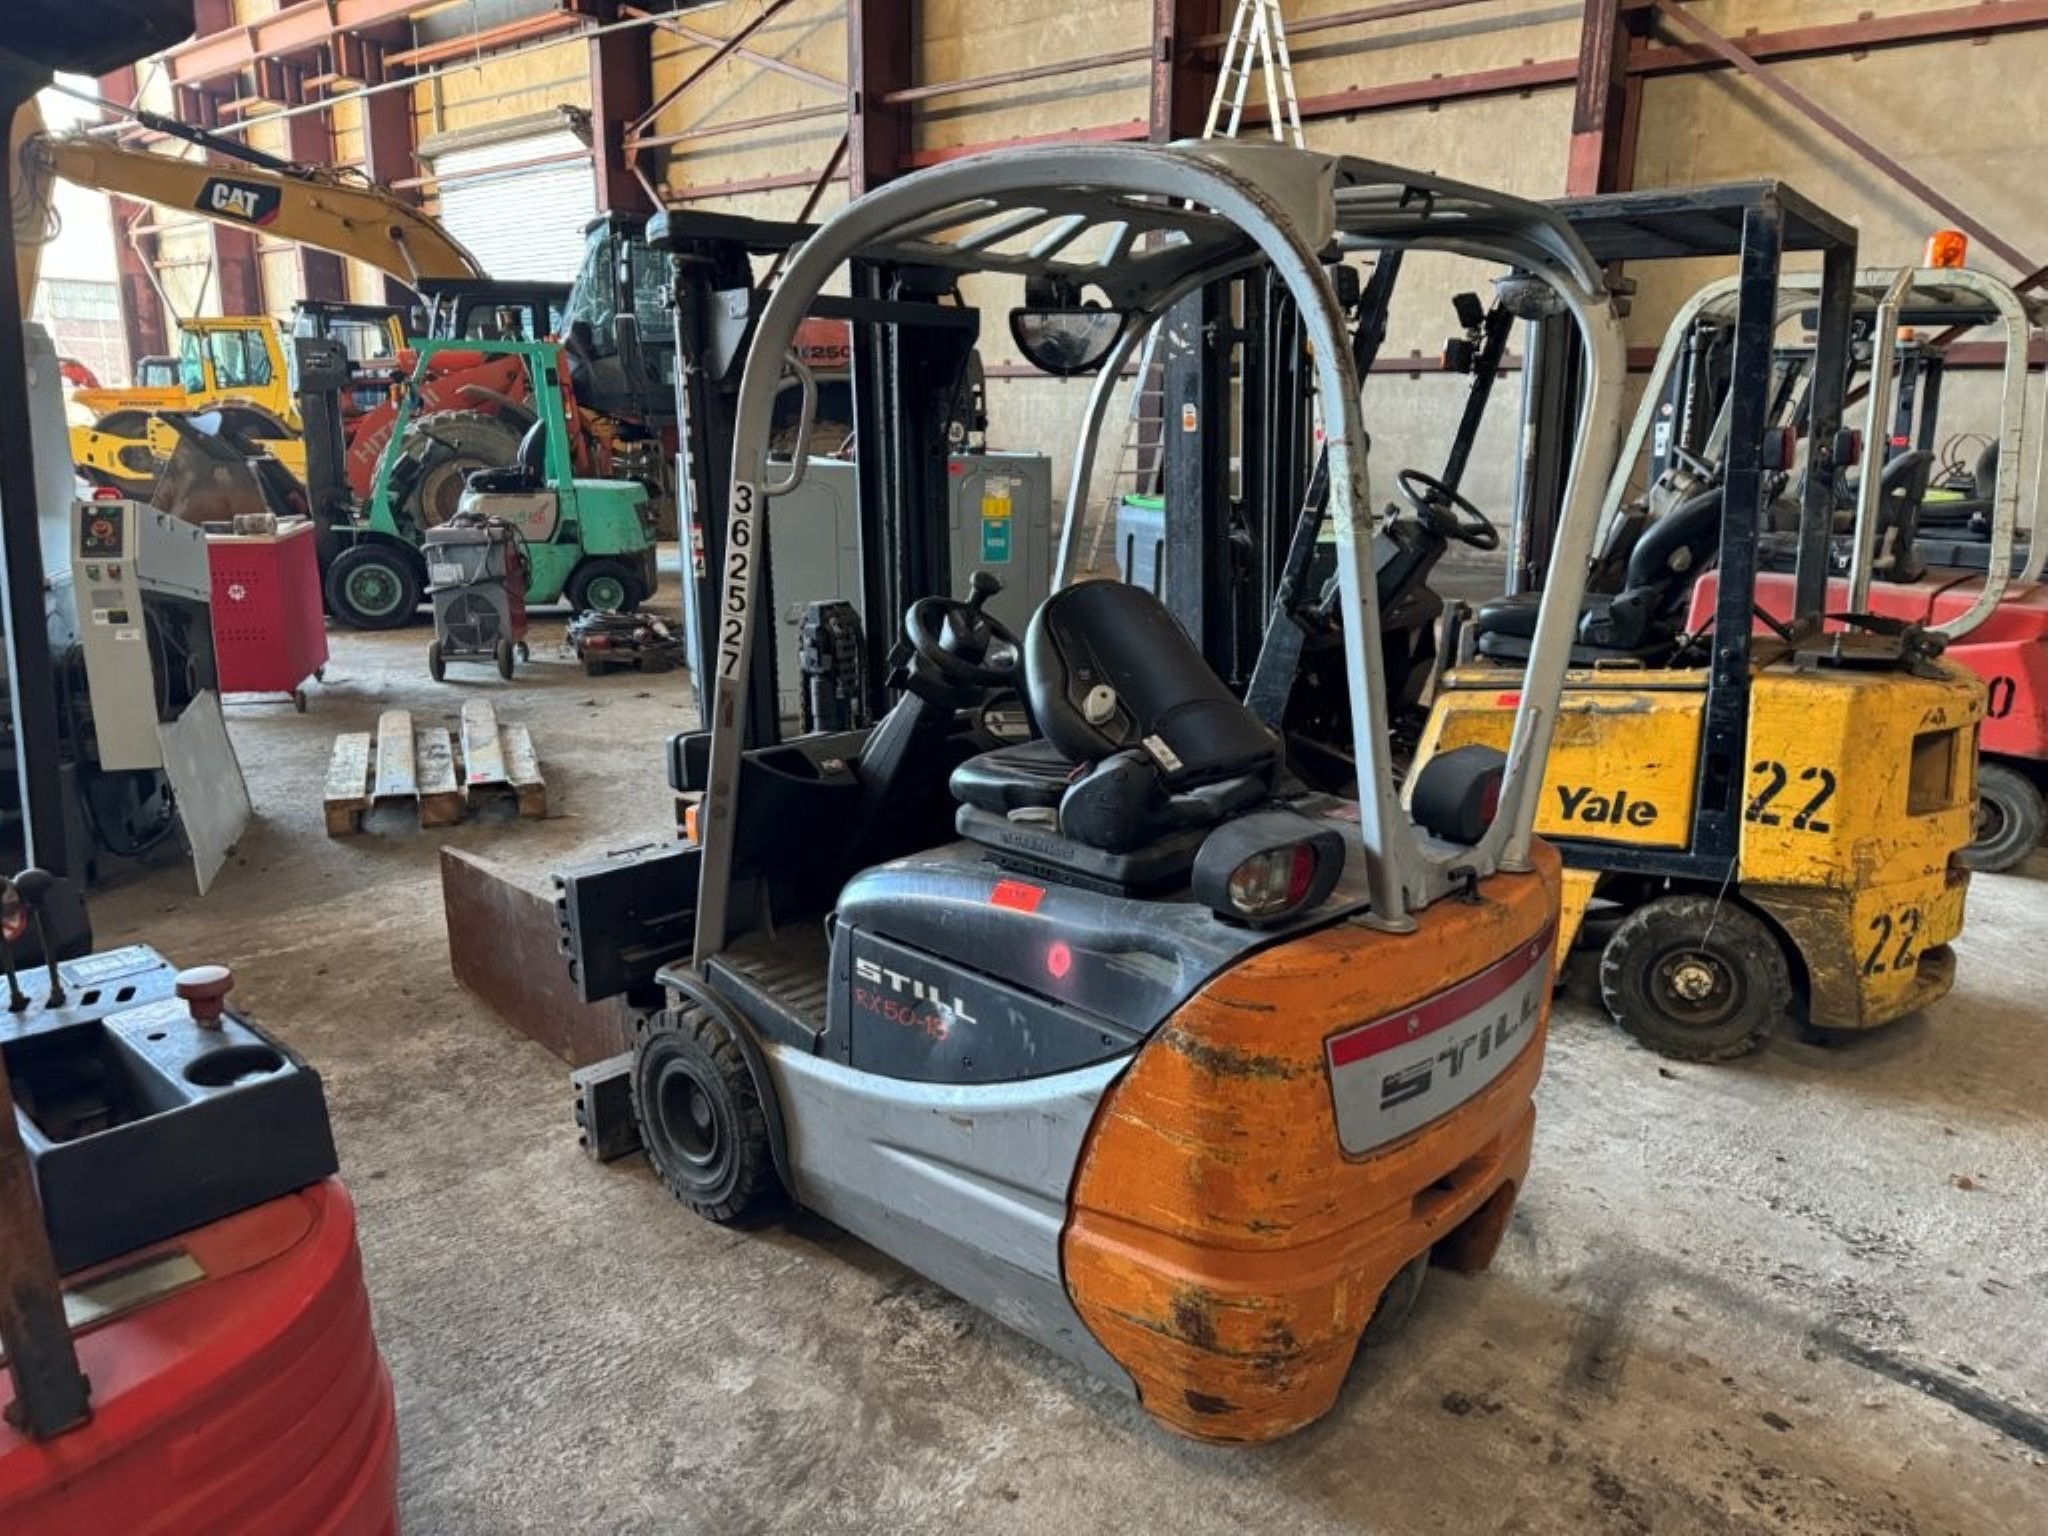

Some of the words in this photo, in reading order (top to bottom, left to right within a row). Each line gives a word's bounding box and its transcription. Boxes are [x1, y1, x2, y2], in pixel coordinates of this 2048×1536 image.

[211, 183, 259, 219] CAT
[721, 484, 753, 676] 362527
[1557, 784, 1659, 828] Yale
[1745, 760, 1837, 834] 22
[1863, 907, 1920, 977] 22
[856, 956, 978, 1025] STILL
[1379, 991, 1540, 1112] STILL
